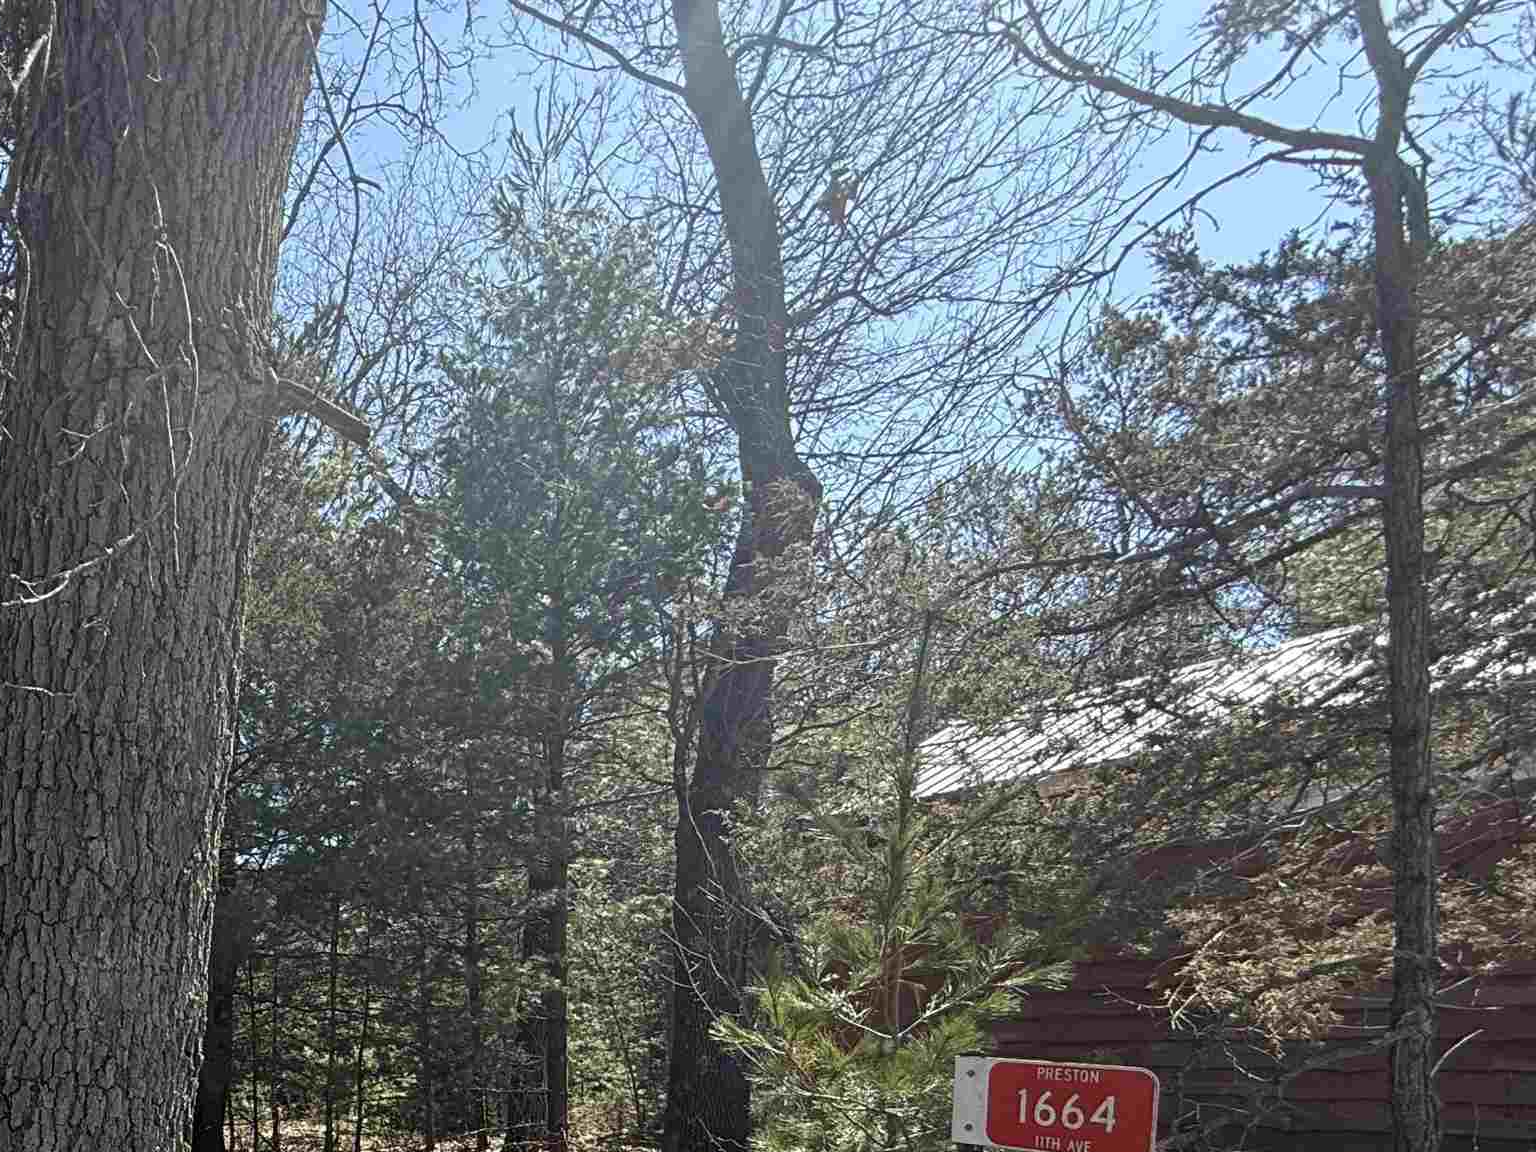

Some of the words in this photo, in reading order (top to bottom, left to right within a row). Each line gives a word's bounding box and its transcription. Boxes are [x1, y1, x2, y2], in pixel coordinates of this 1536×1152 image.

[1037, 1067, 1100, 1083] PRESTON
[1017, 1088, 1116, 1133] 1664
[1035, 1135, 1061, 1150] 11TH
